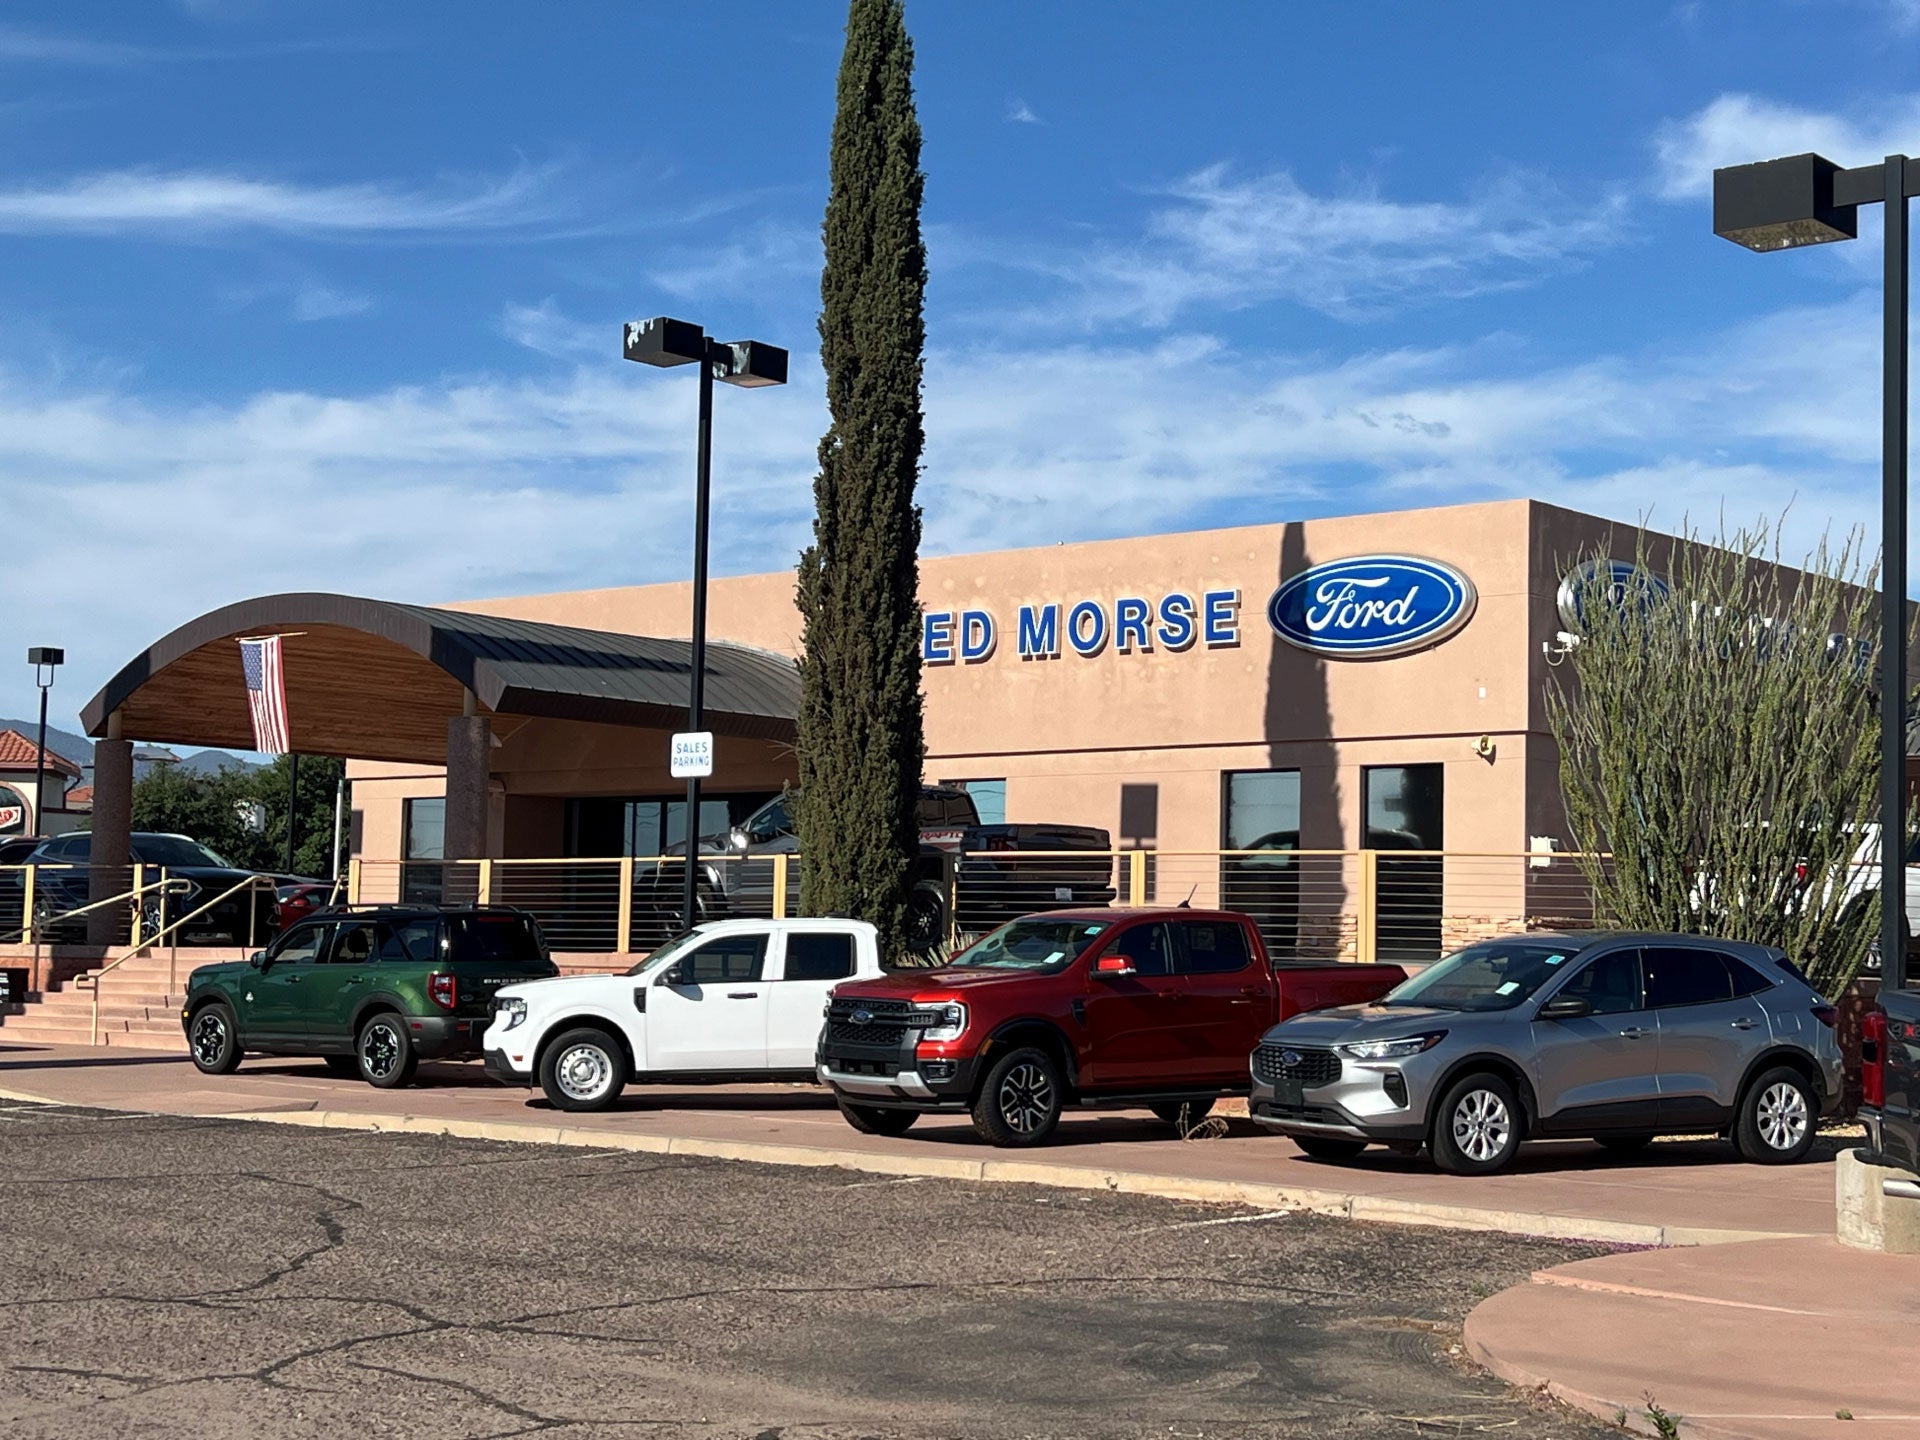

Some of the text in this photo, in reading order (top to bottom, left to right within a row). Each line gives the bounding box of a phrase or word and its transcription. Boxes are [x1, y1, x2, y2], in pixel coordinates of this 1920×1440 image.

[1306, 576, 1420, 631] Ford
[923, 589, 1241, 662] ED MORSE
[673, 755, 710, 767] PARKING
[676, 742, 708, 754] SALES
